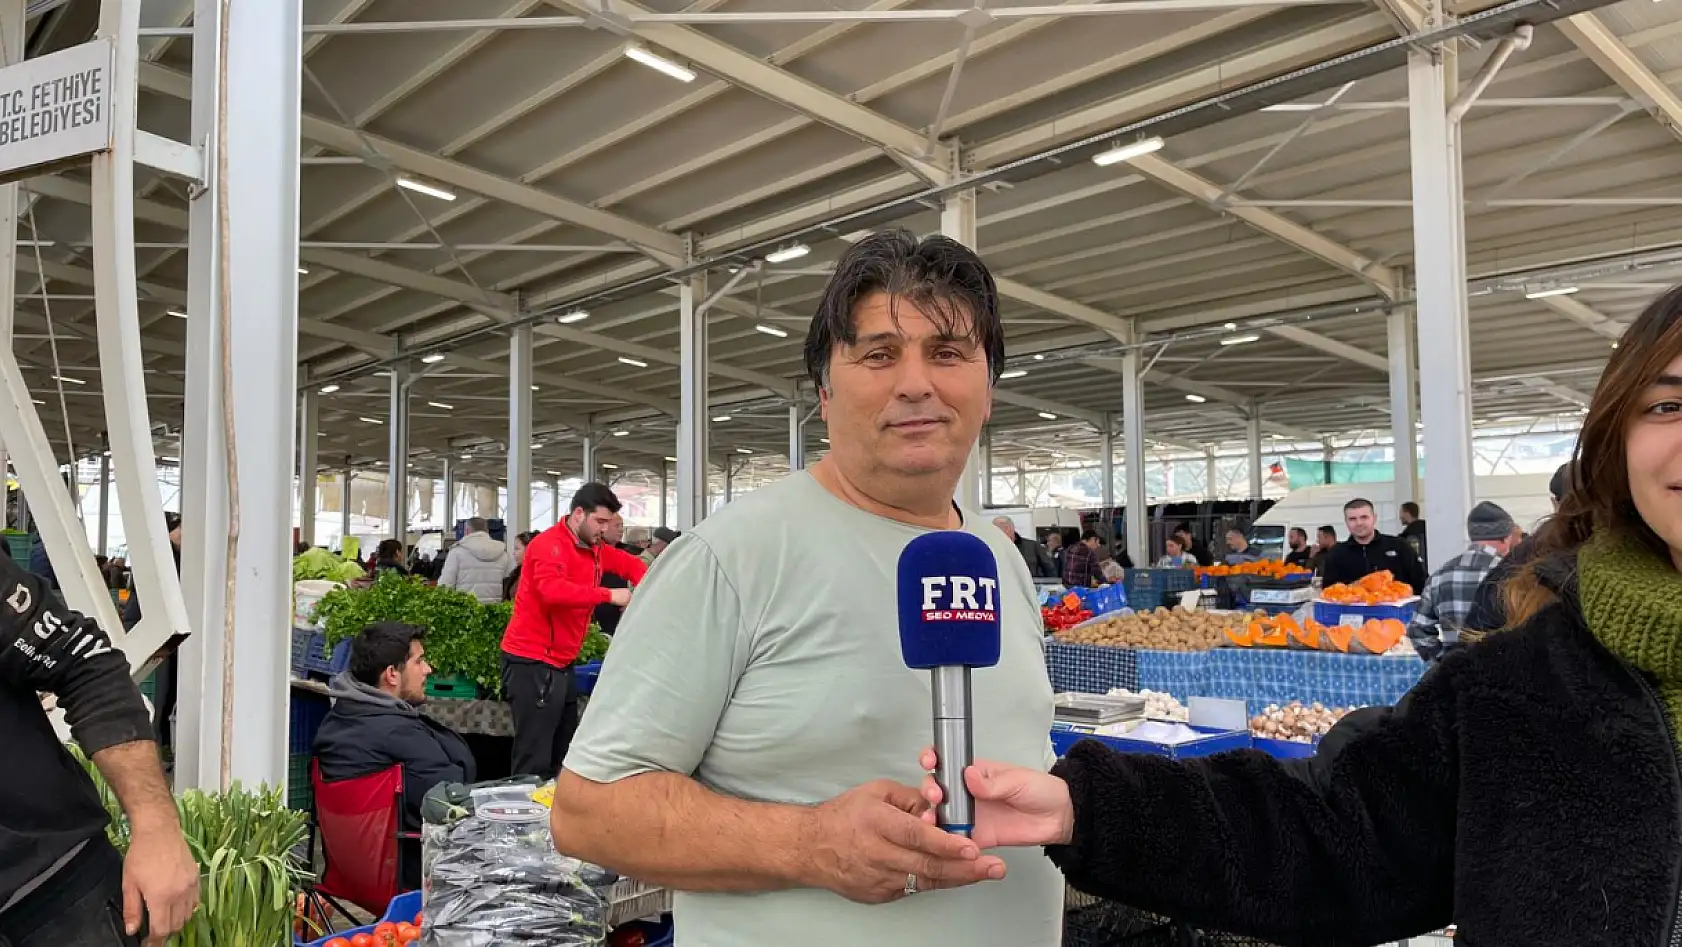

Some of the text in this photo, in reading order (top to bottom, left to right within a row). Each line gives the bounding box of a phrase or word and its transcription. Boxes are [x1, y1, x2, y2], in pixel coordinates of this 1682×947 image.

[0, 68, 102, 118] T.C. FETHİYE
[0, 97, 101, 146] BELEDİYESİ
[921, 576, 996, 610] FRT
[926, 611, 995, 621] SEO MEDYA
